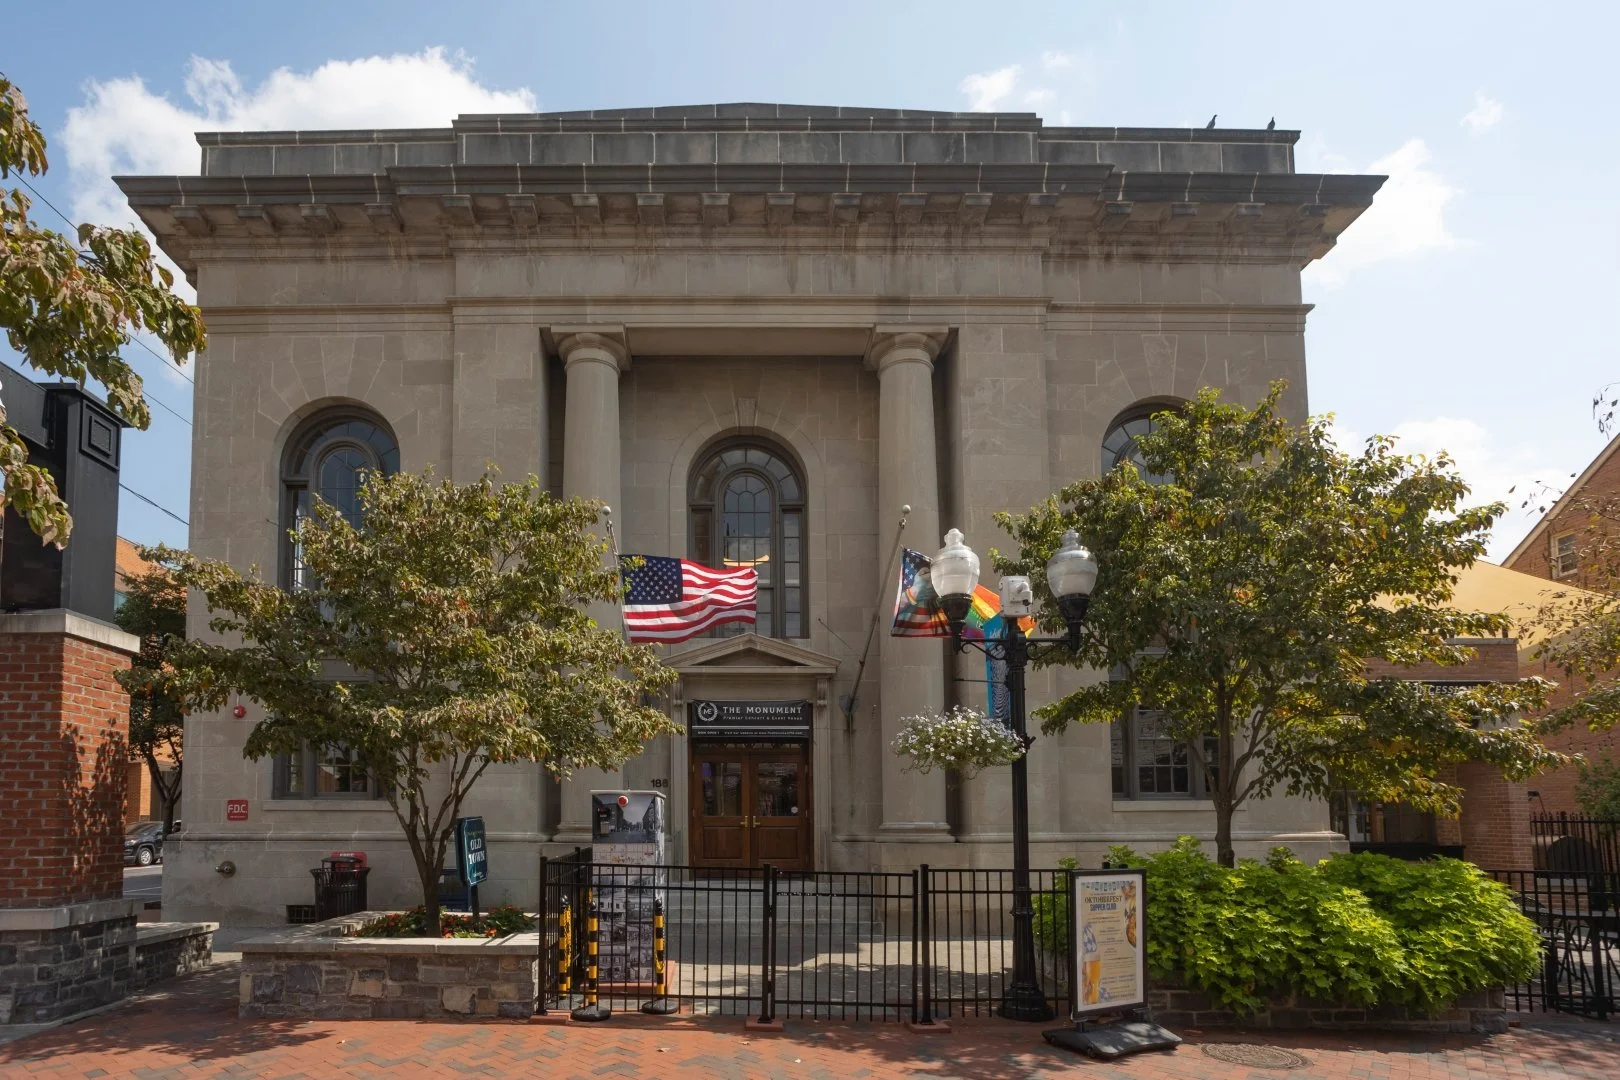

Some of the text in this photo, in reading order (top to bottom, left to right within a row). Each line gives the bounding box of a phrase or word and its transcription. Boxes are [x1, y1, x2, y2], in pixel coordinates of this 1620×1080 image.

[722, 706, 803, 714] THE MONUMENT
[470, 839, 482, 851] OLD
[468, 851, 485, 865] TOWN
